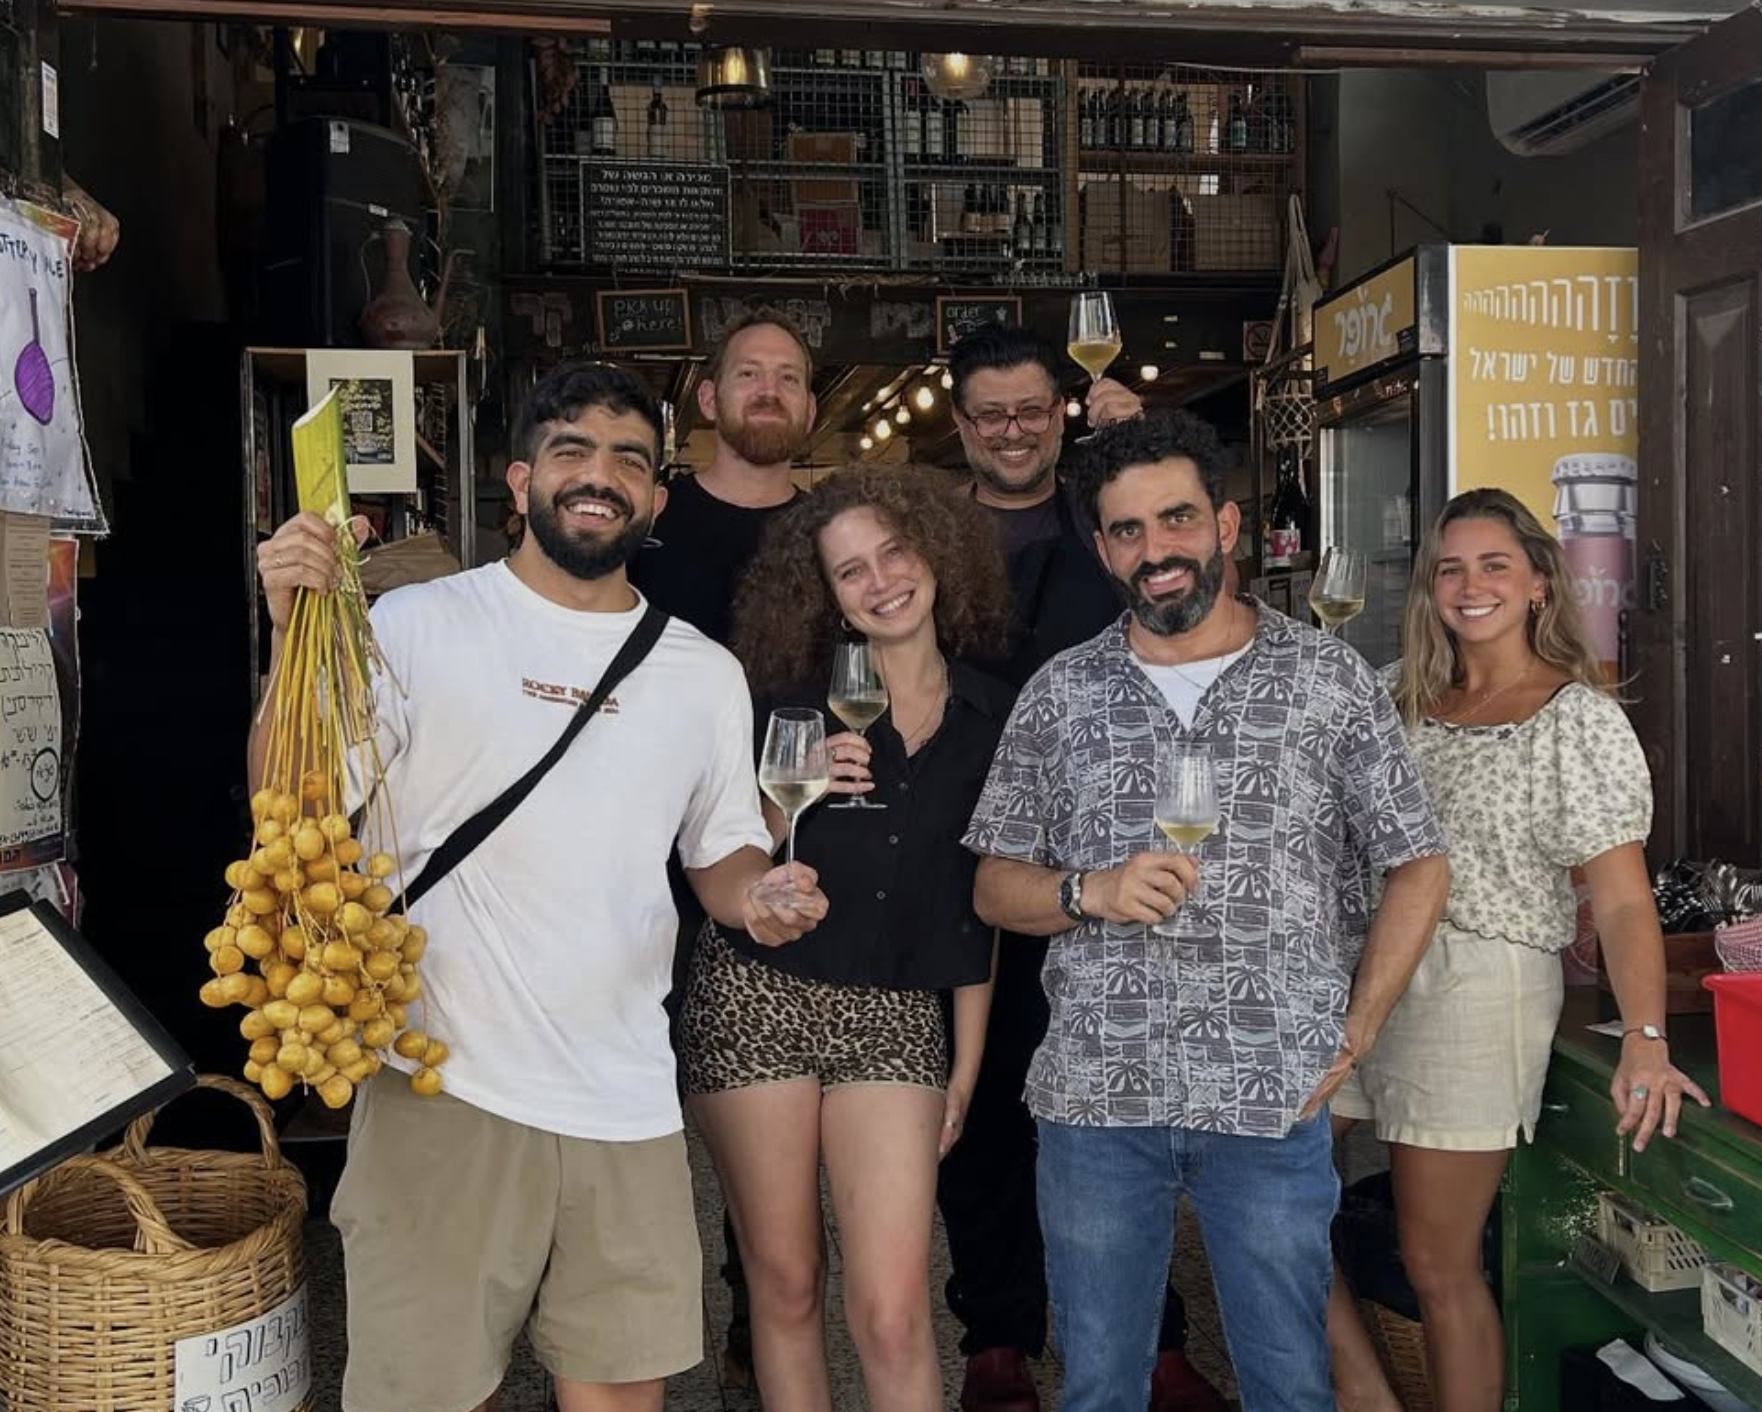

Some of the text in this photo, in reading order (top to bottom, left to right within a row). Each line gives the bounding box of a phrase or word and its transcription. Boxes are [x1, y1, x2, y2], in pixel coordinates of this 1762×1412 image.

[1469, 347, 1538, 382] ישראל
[1546, 350, 1576, 384] של
[1487, 402, 1556, 441] וזהו!
[1566, 400, 1599, 438] גז
